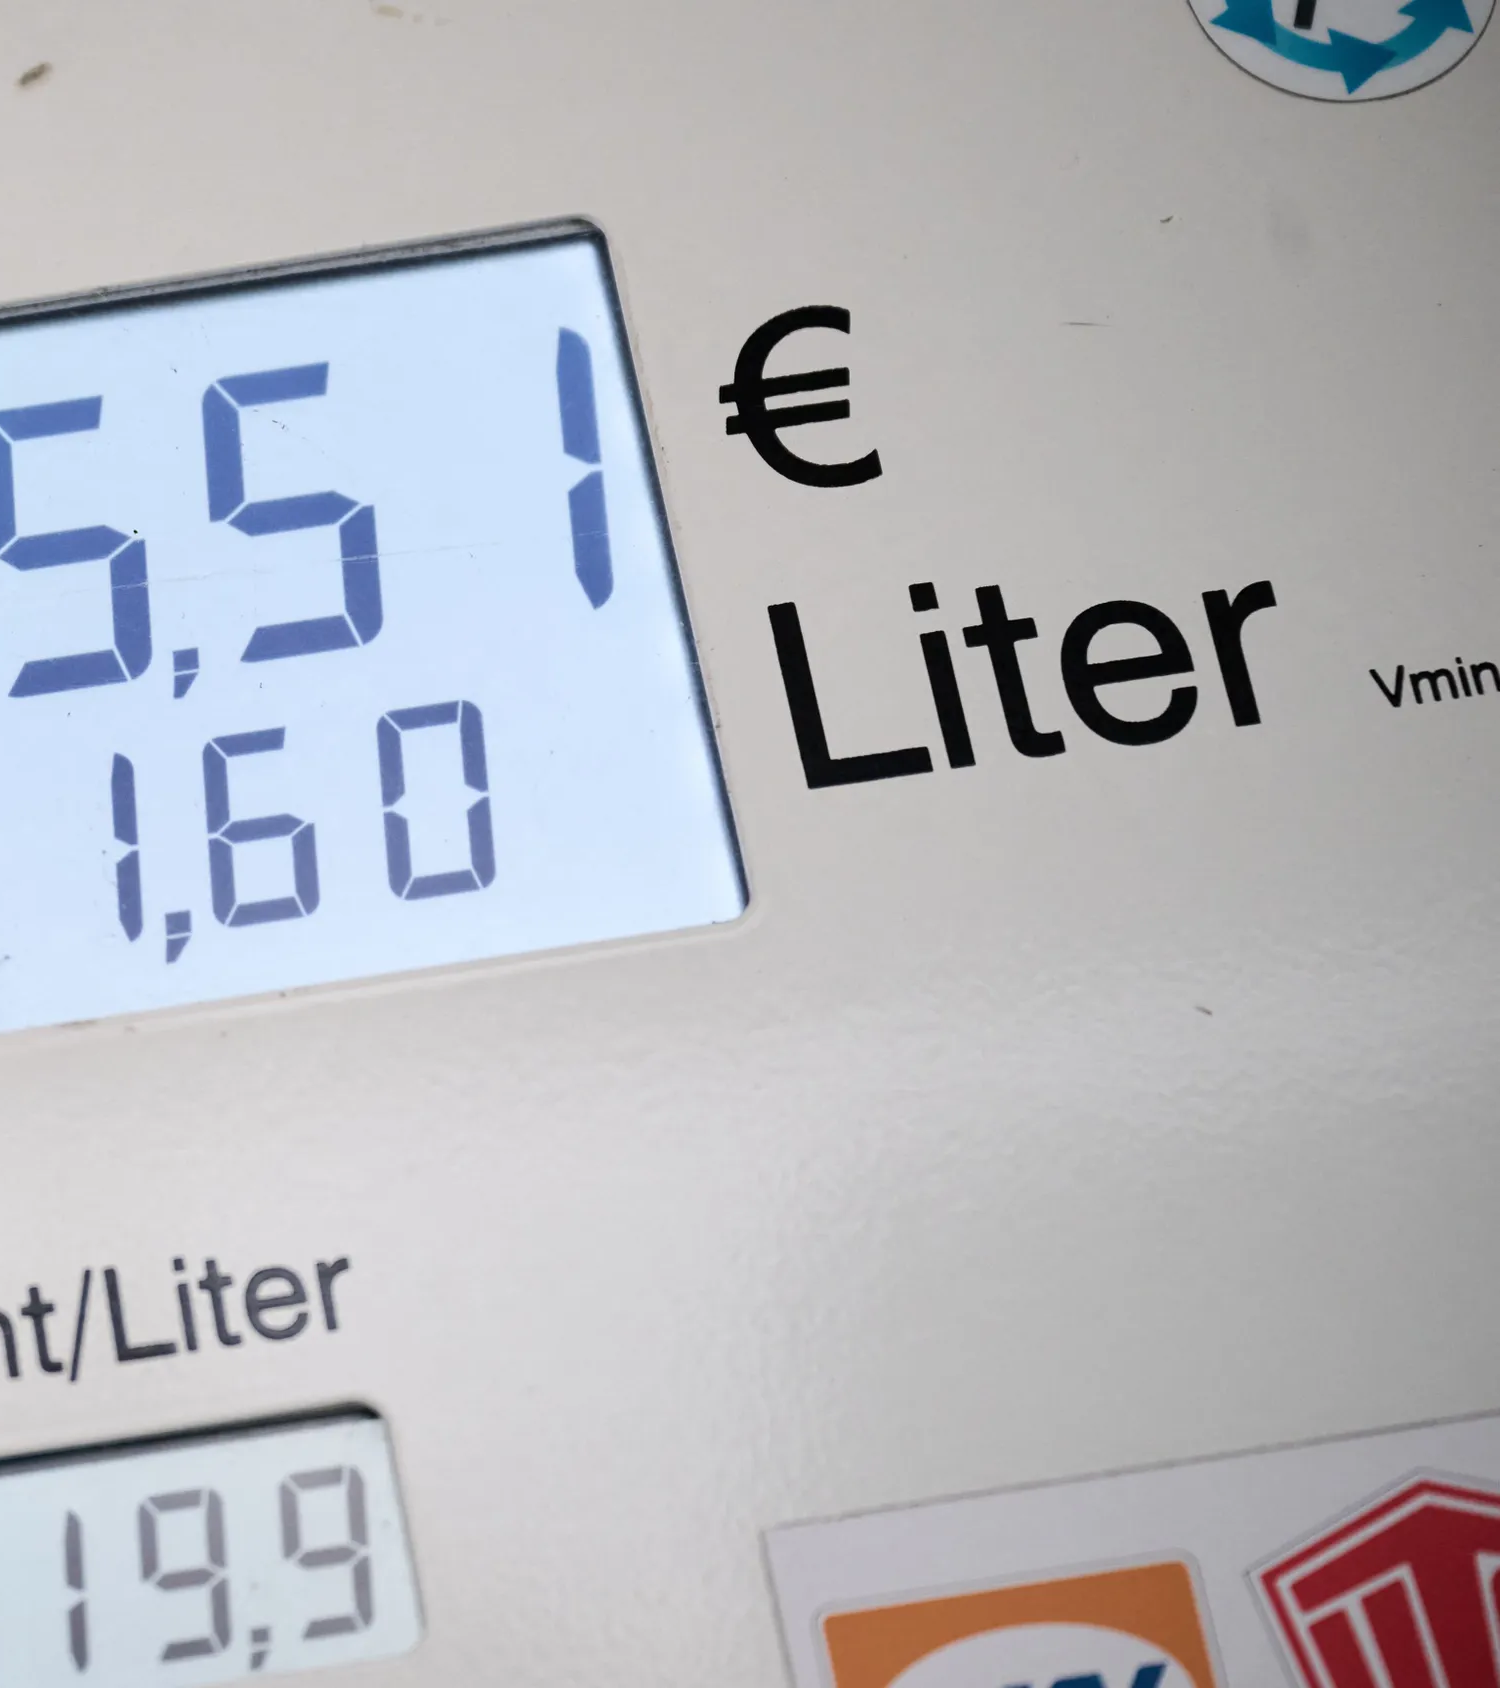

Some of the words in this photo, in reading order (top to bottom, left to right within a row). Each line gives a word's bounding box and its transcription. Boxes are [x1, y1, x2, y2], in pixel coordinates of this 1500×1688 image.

[719, 305, 882, 488] €
[767, 580, 1277, 790] Liter
[1368, 656, 1500, 708] Vmin
